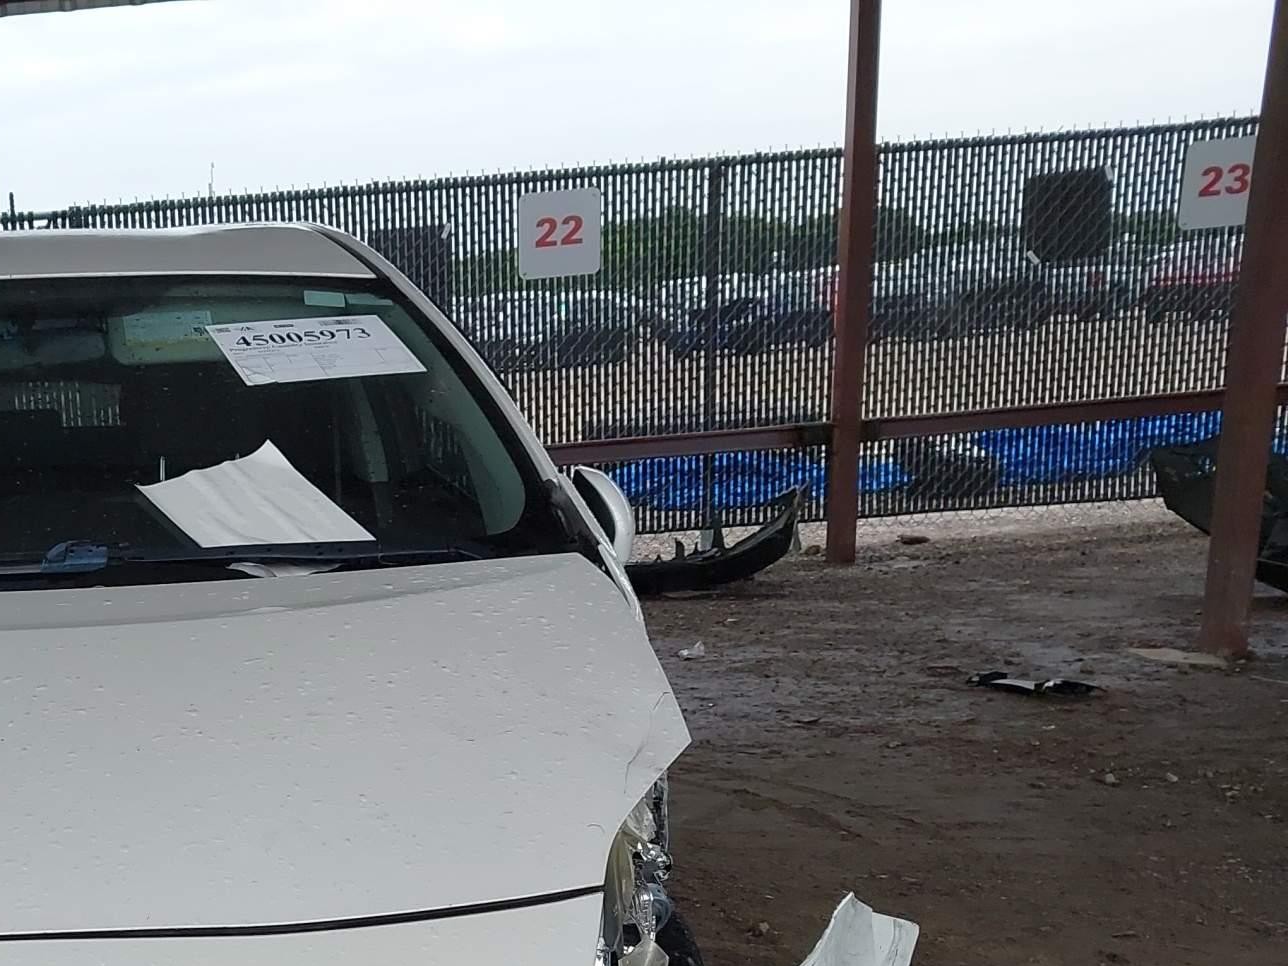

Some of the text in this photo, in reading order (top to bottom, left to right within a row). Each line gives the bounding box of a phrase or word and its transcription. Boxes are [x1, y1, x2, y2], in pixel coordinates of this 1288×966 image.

[1198, 163, 1251, 198] 23
[535, 215, 584, 249] 22
[235, 327, 371, 347] 45005973
